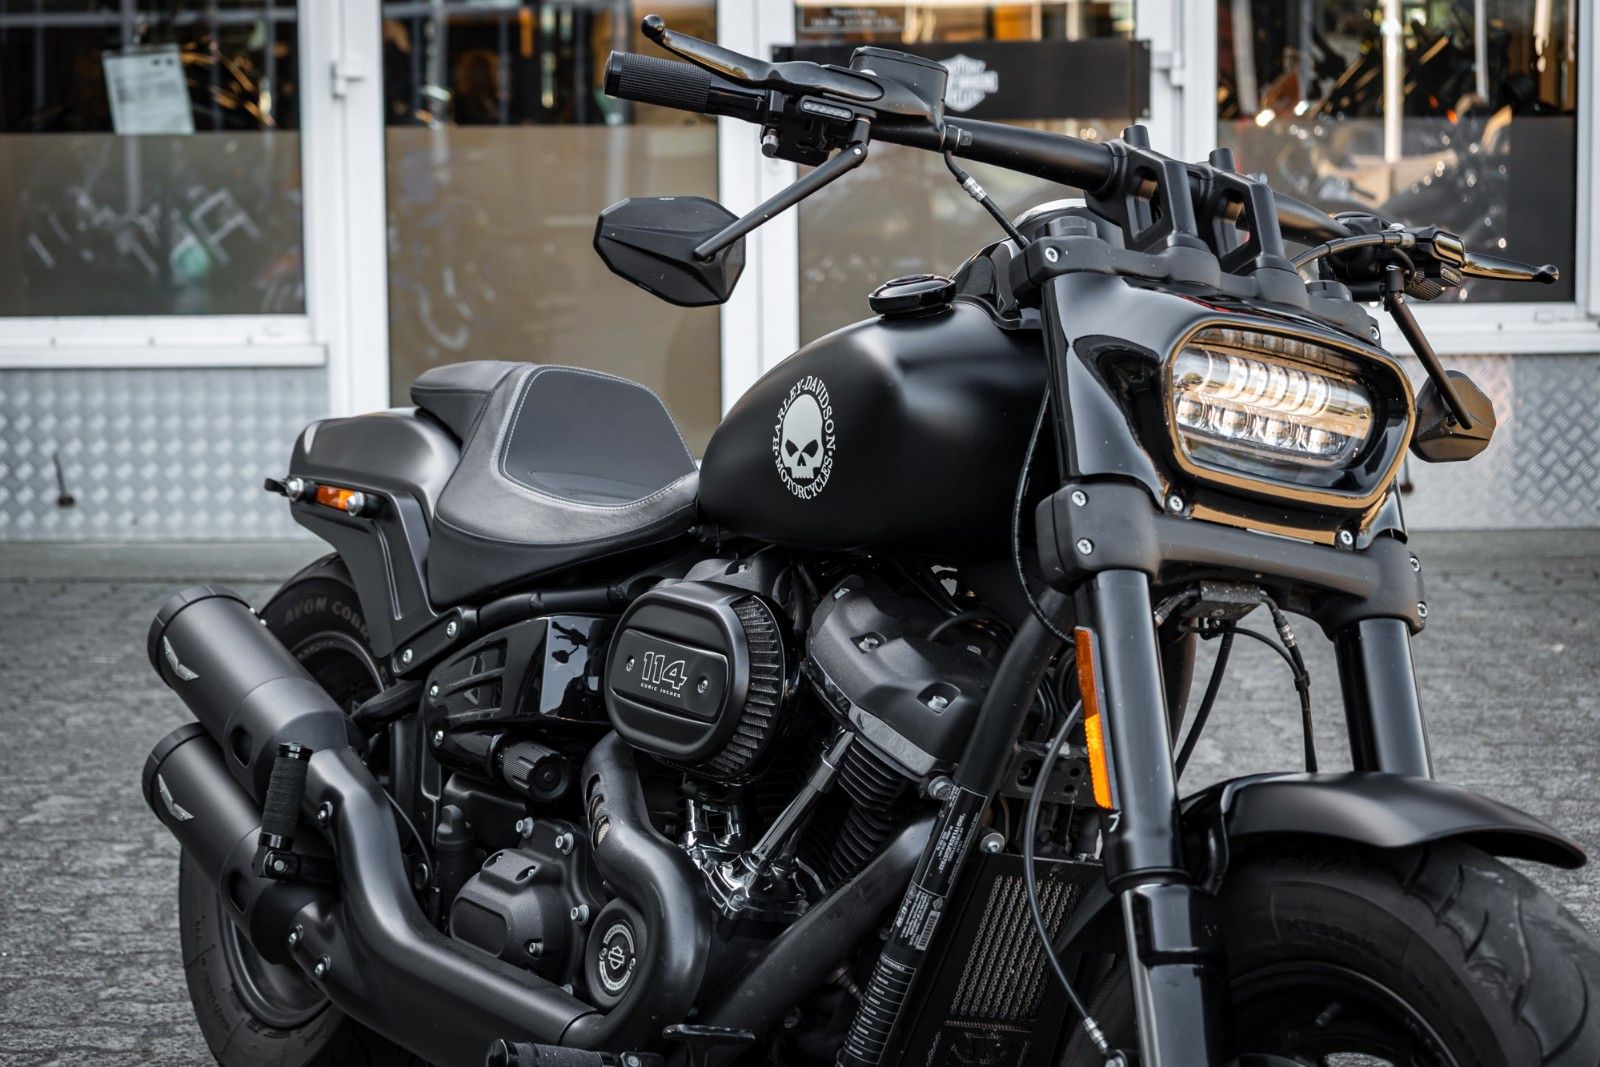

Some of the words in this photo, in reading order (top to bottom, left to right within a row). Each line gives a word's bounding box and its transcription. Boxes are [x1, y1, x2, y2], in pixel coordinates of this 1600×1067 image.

[772, 375, 836, 451] HARLEY-DAVIDSON
[775, 455, 833, 499] MOTORCYCLES
[284, 597, 327, 625] AVON
[331, 601, 369, 641] COBR
[641, 651, 688, 690] 114
